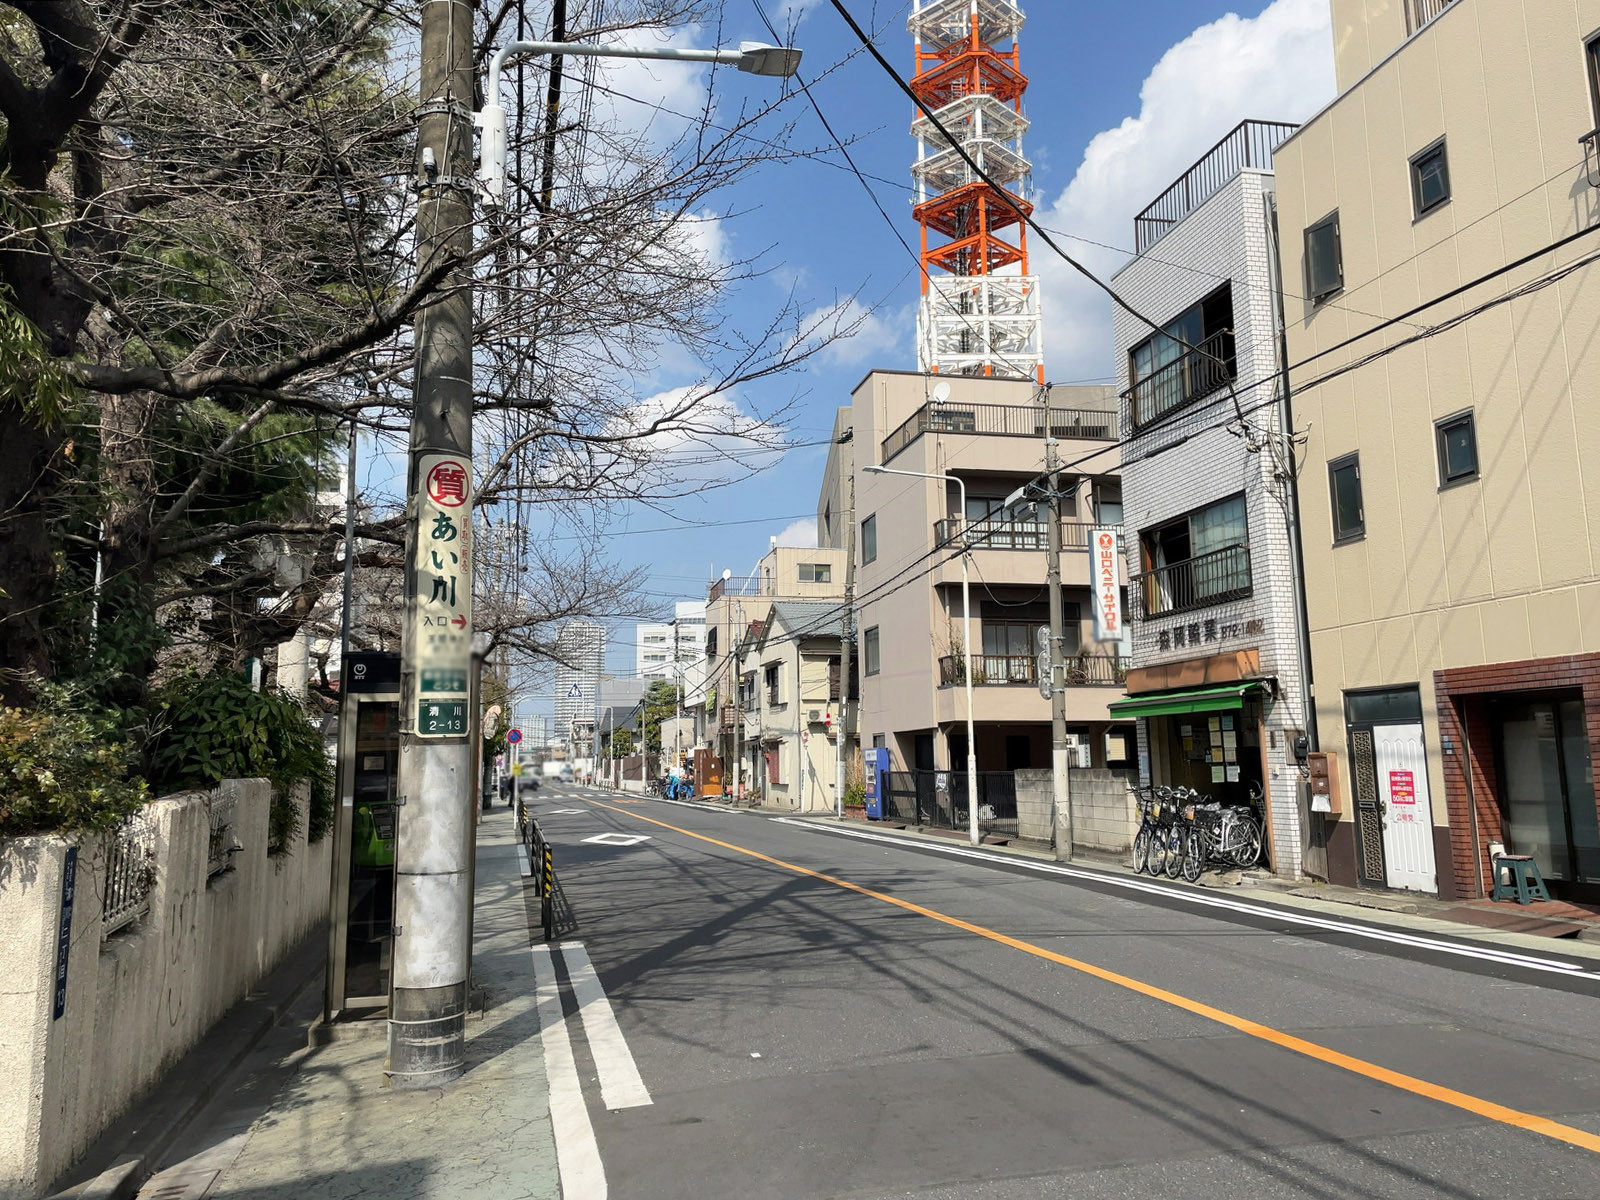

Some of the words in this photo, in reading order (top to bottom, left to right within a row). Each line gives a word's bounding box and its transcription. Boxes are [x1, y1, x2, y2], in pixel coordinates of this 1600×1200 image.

[432, 467, 466, 502] 質
[430, 511, 459, 607] あい川
[423, 616, 448, 626] 入口
[428, 705, 462, 717] 清川
[429, 720, 461, 731] 2-13
